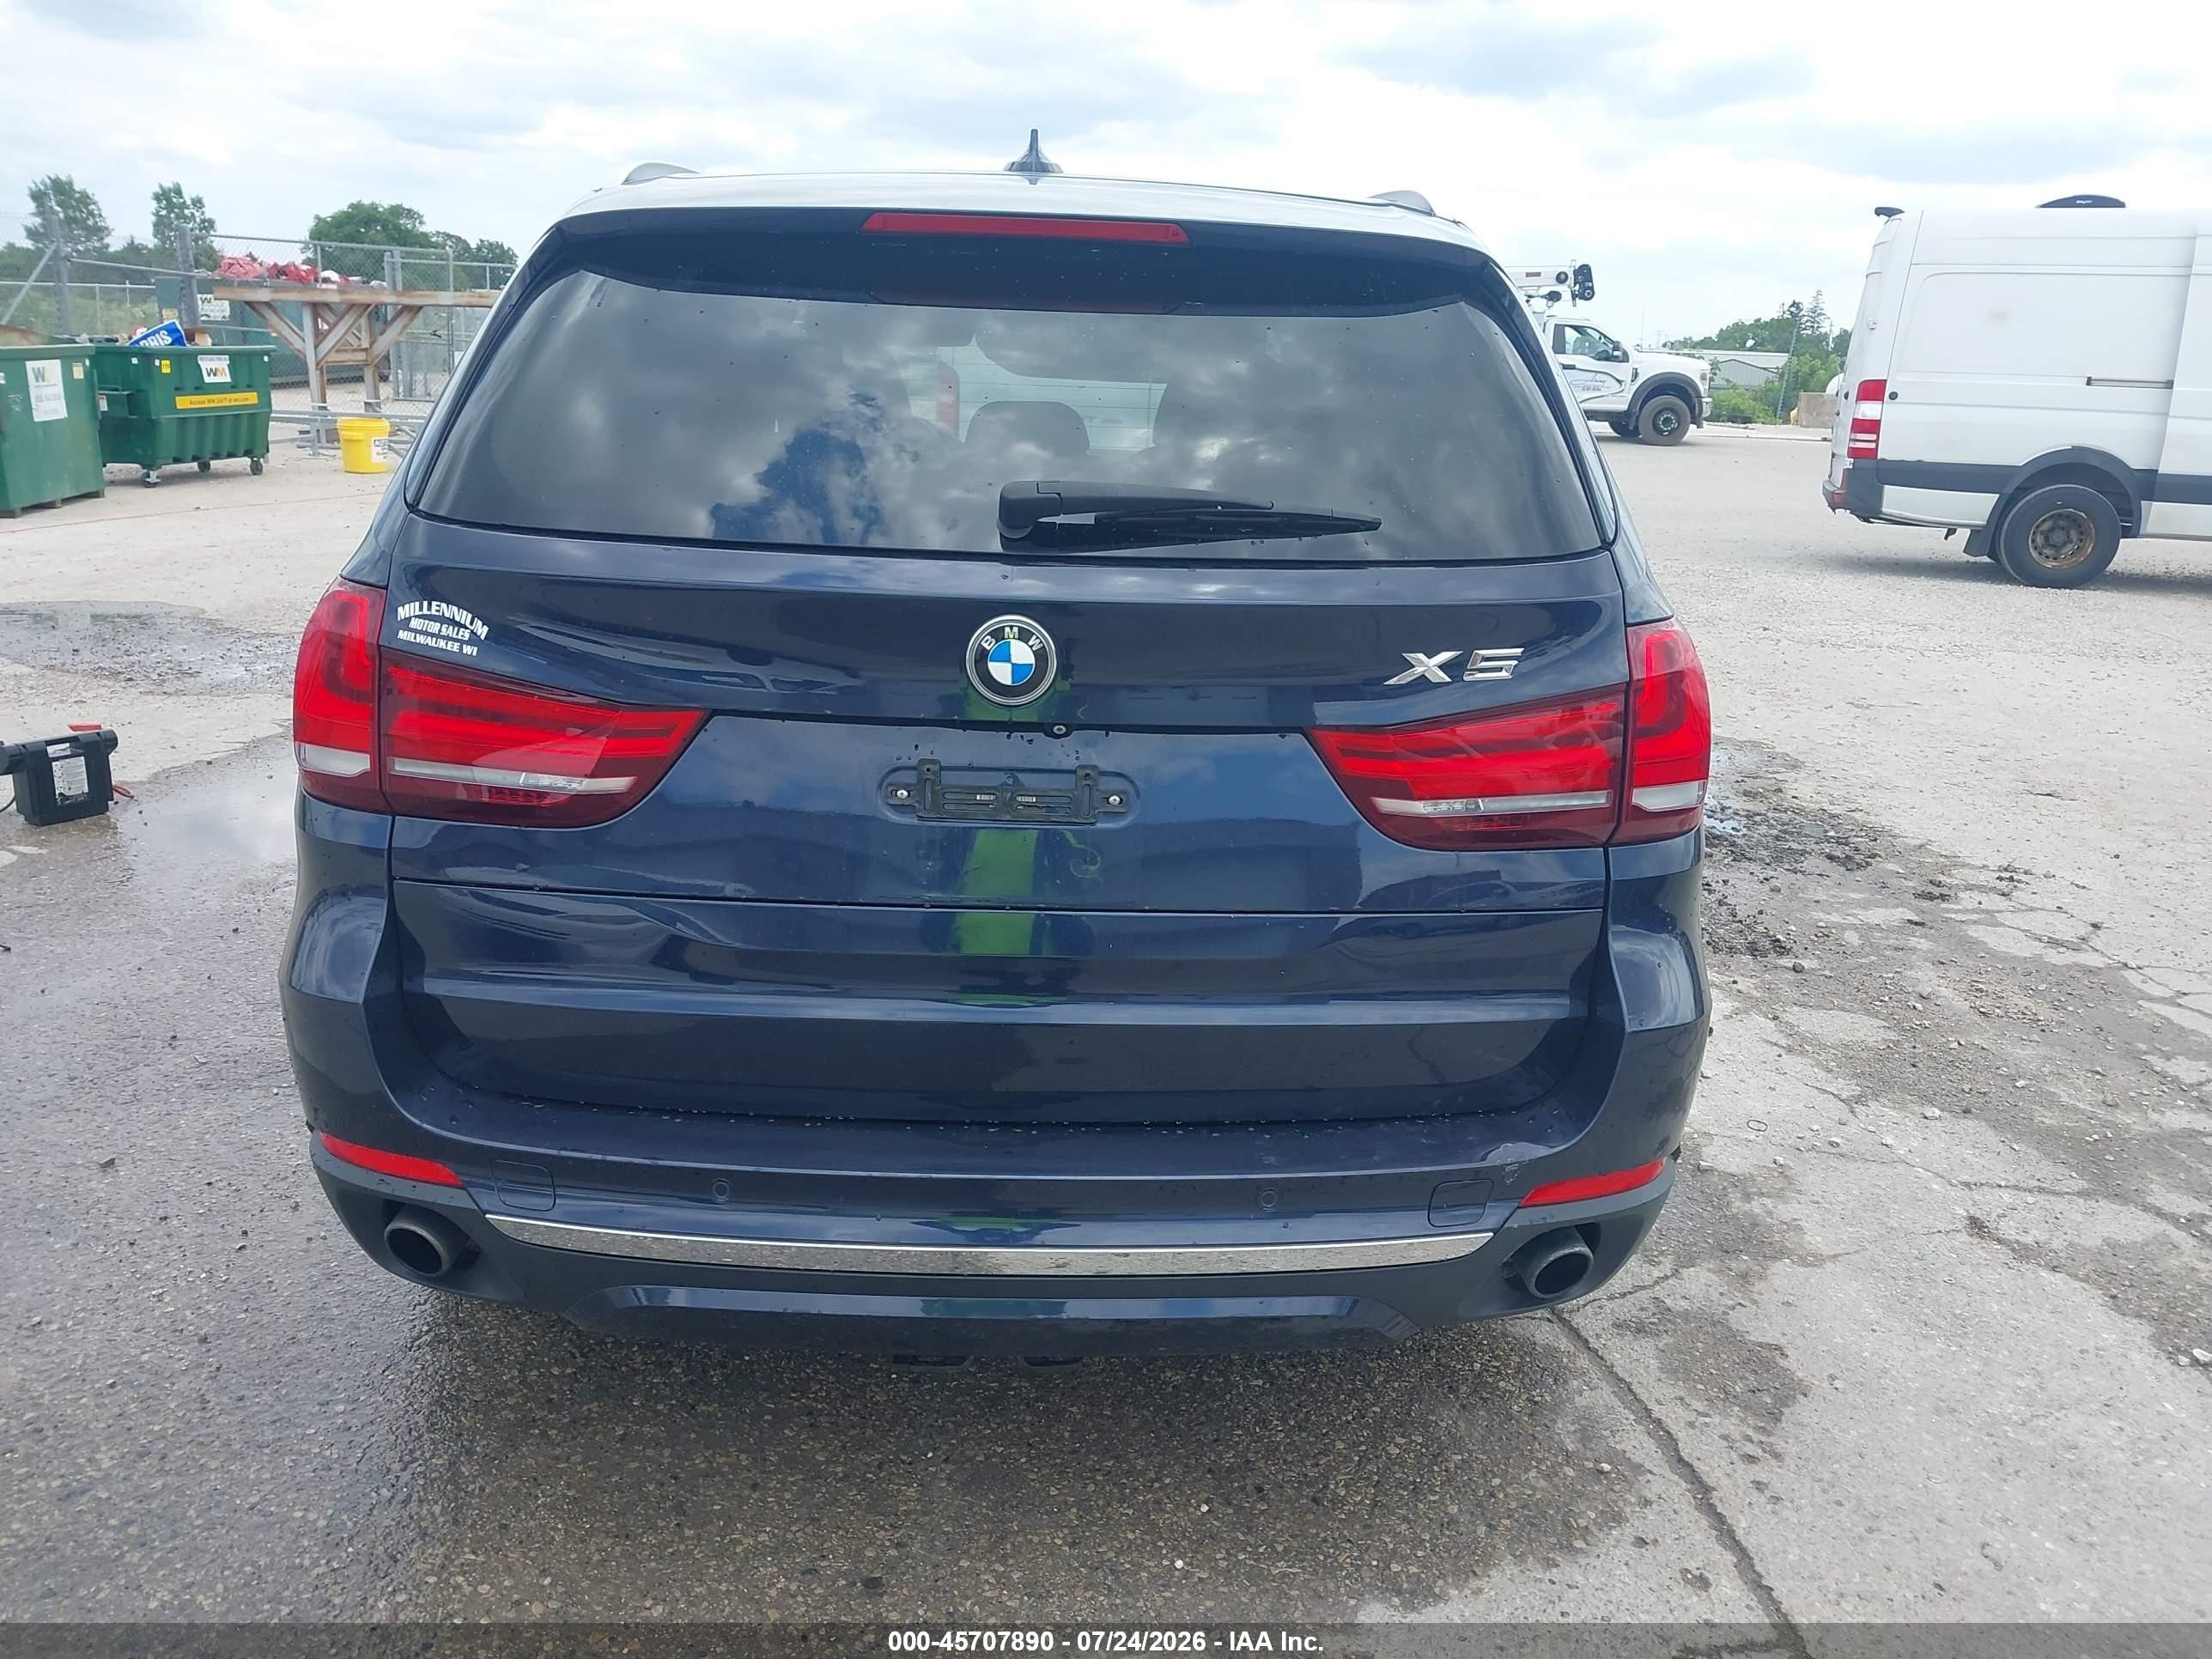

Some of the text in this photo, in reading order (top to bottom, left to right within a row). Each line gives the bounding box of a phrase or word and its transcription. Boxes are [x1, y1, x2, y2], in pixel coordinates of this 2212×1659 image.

[205, 367, 227, 378] WM
[398, 600, 489, 641] MILLENNIUM
[409, 617, 471, 641] MOTOR SALES
[397, 629, 478, 657] MILWAUKEE WI
[981, 626, 1043, 651] BMW
[1383, 647, 1525, 685] X5
